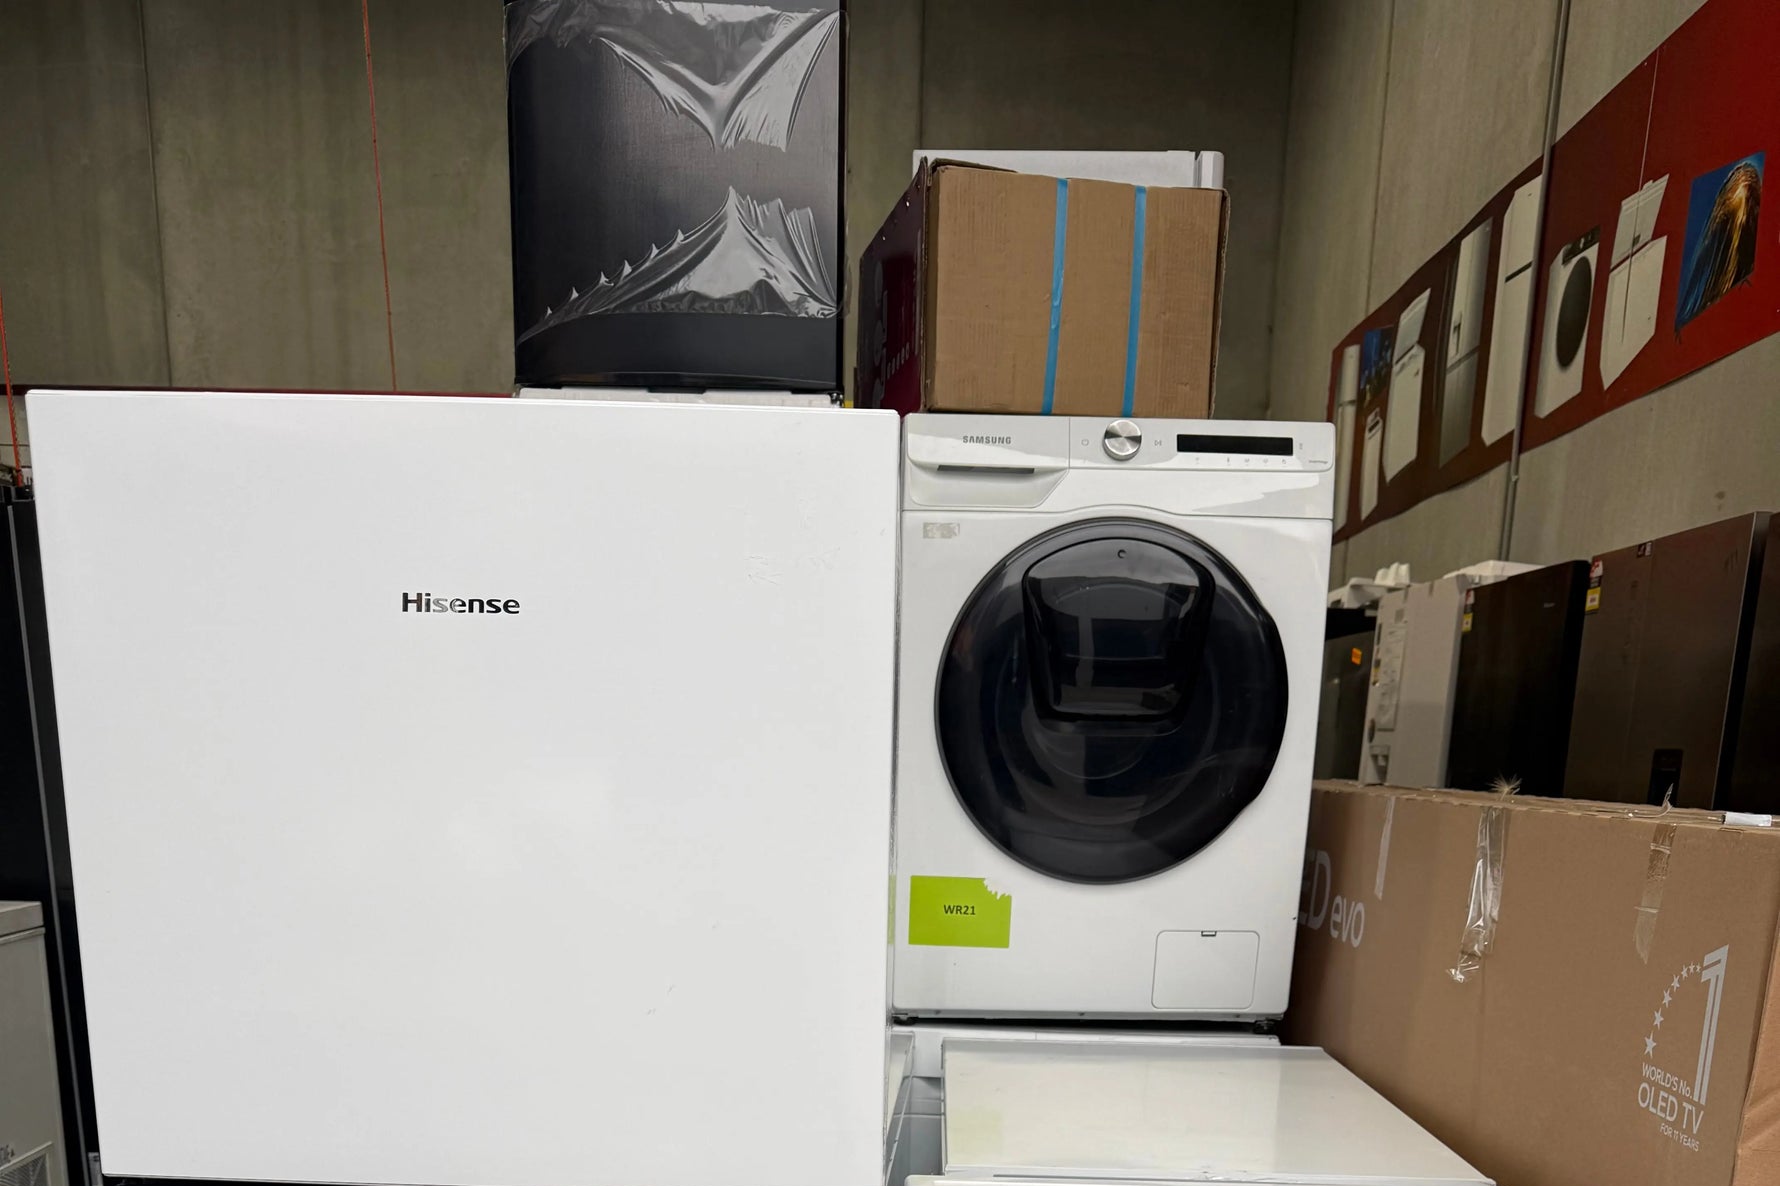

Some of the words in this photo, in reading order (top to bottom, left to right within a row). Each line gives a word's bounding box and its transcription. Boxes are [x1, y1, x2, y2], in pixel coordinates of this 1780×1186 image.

[963, 435, 1012, 445] SAMSUNG
[402, 592, 520, 615] Hisense
[943, 904, 977, 916] WR21
[1330, 895, 1366, 948] evo
[1642, 1062, 1679, 1092] WORLD'S
[1679, 1079, 1693, 1100] No.
[1638, 1082, 1679, 1122] OLED
[1682, 1102, 1705, 1135] TV
[1660, 1122, 1673, 1138] FOR
[1679, 1132, 1700, 1152] YEARS
